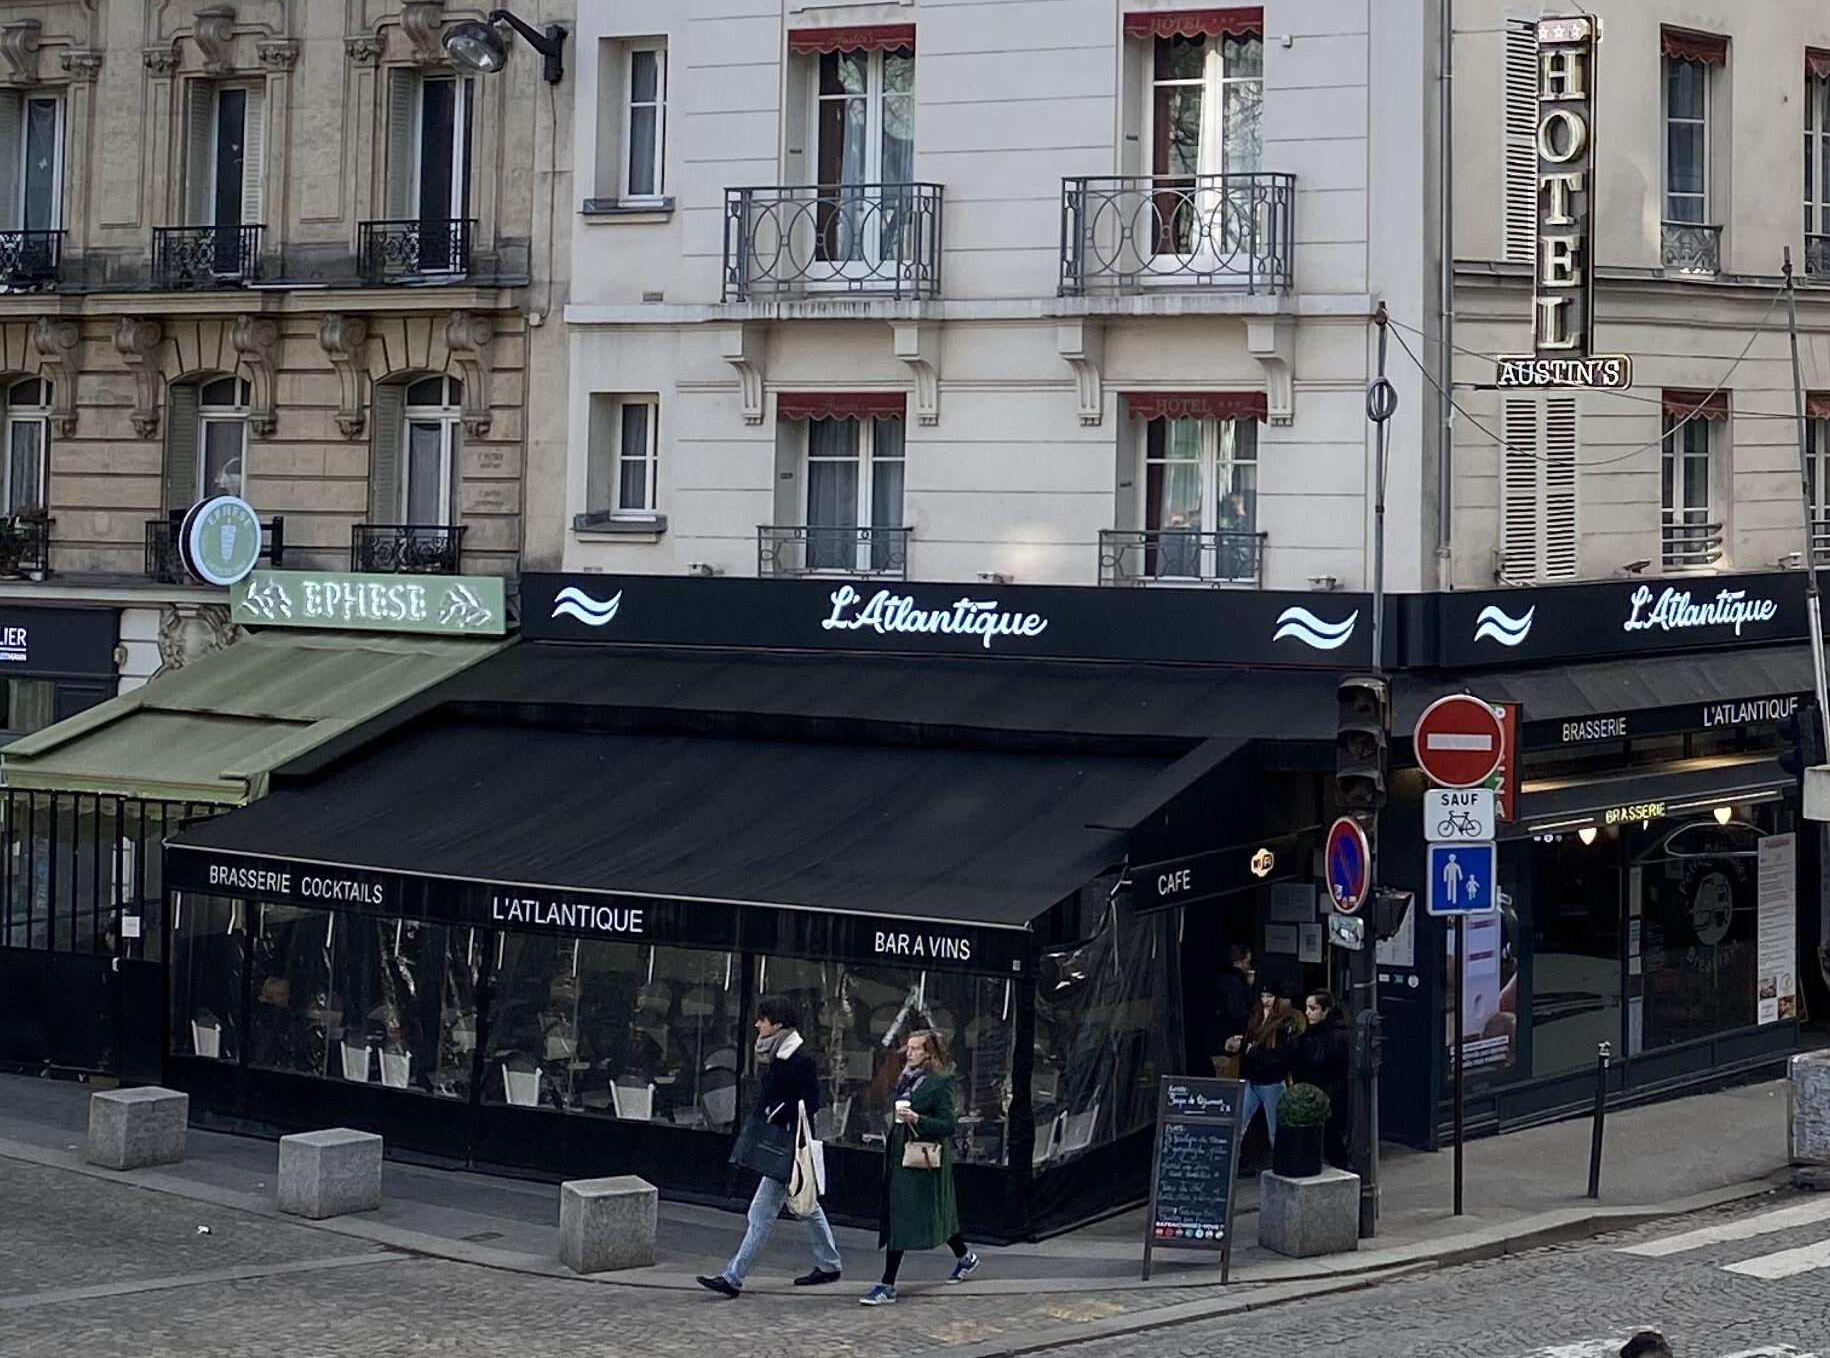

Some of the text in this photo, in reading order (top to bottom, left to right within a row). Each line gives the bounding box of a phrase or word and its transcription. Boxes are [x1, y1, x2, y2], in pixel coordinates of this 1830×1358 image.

[1537, 48, 1587, 350] HOTEL
[1498, 359, 1621, 388] AUSTIN'S
[302, 580, 428, 622] EPHESE
[822, 585, 1048, 648] L'Atlantique
[1623, 585, 1778, 637] L'Atlantique
[1562, 717, 1627, 741] BRASSERIE
[1703, 696, 1799, 728] L'ATLANTIQUE
[1441, 793, 1479, 806] SAUF
[1605, 802, 1667, 824] BRASSERIE
[1157, 869, 1191, 895] CAFE
[209, 864, 971, 961] BRASSERIE COCKTAILS L'ATLANTIQUE BAR A VINS
